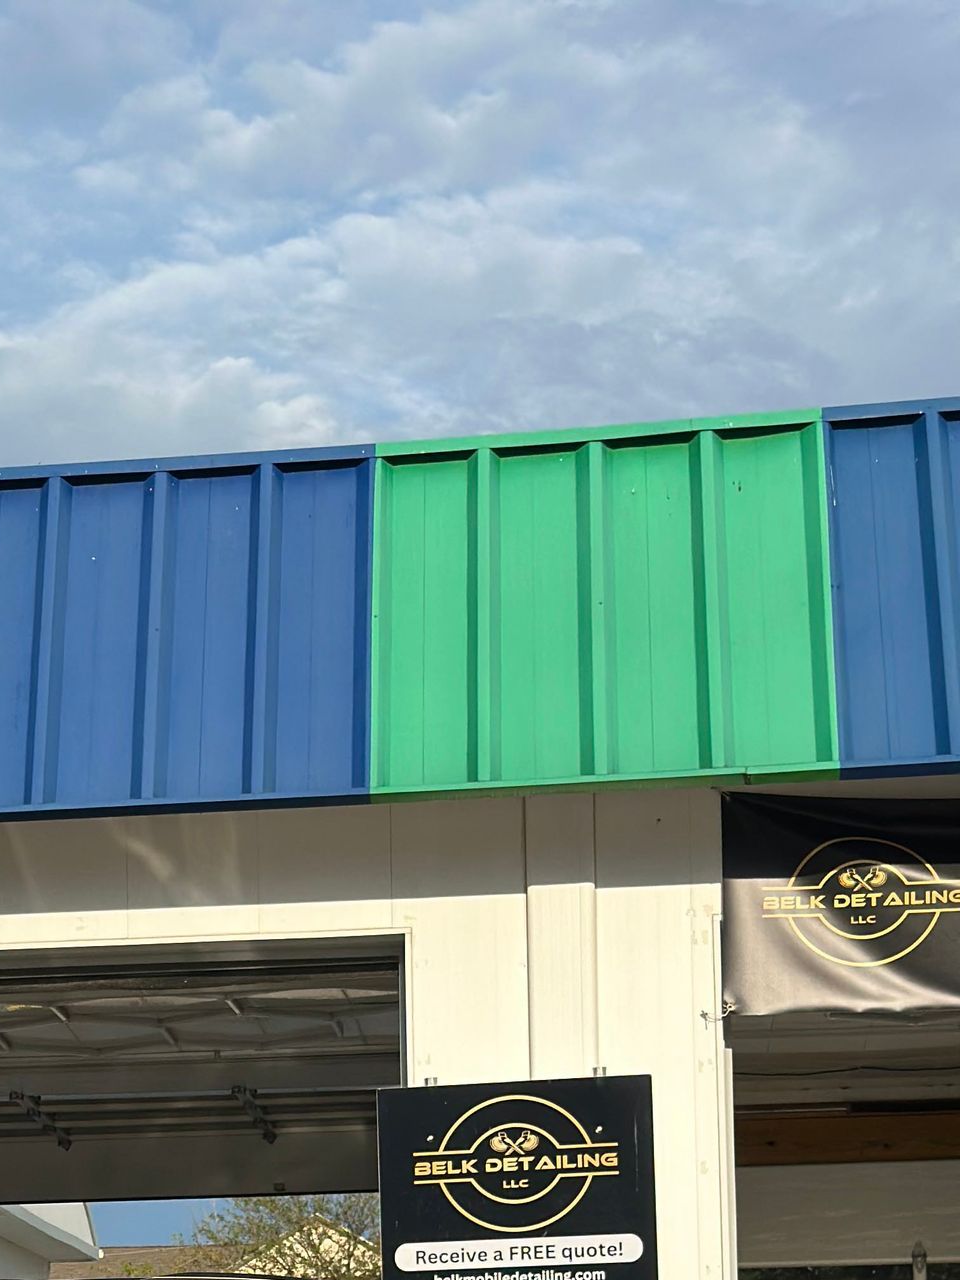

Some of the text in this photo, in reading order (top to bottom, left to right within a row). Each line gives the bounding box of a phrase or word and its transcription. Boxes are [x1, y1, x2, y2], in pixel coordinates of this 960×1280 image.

[762, 889, 960, 909] BELK DETAILING
[850, 915, 876, 925] LLC
[414, 1152, 619, 1176] BELK DETAILING
[502, 1178, 529, 1189] LLC
[415, 1242, 623, 1265] Receive a FREE quote!
